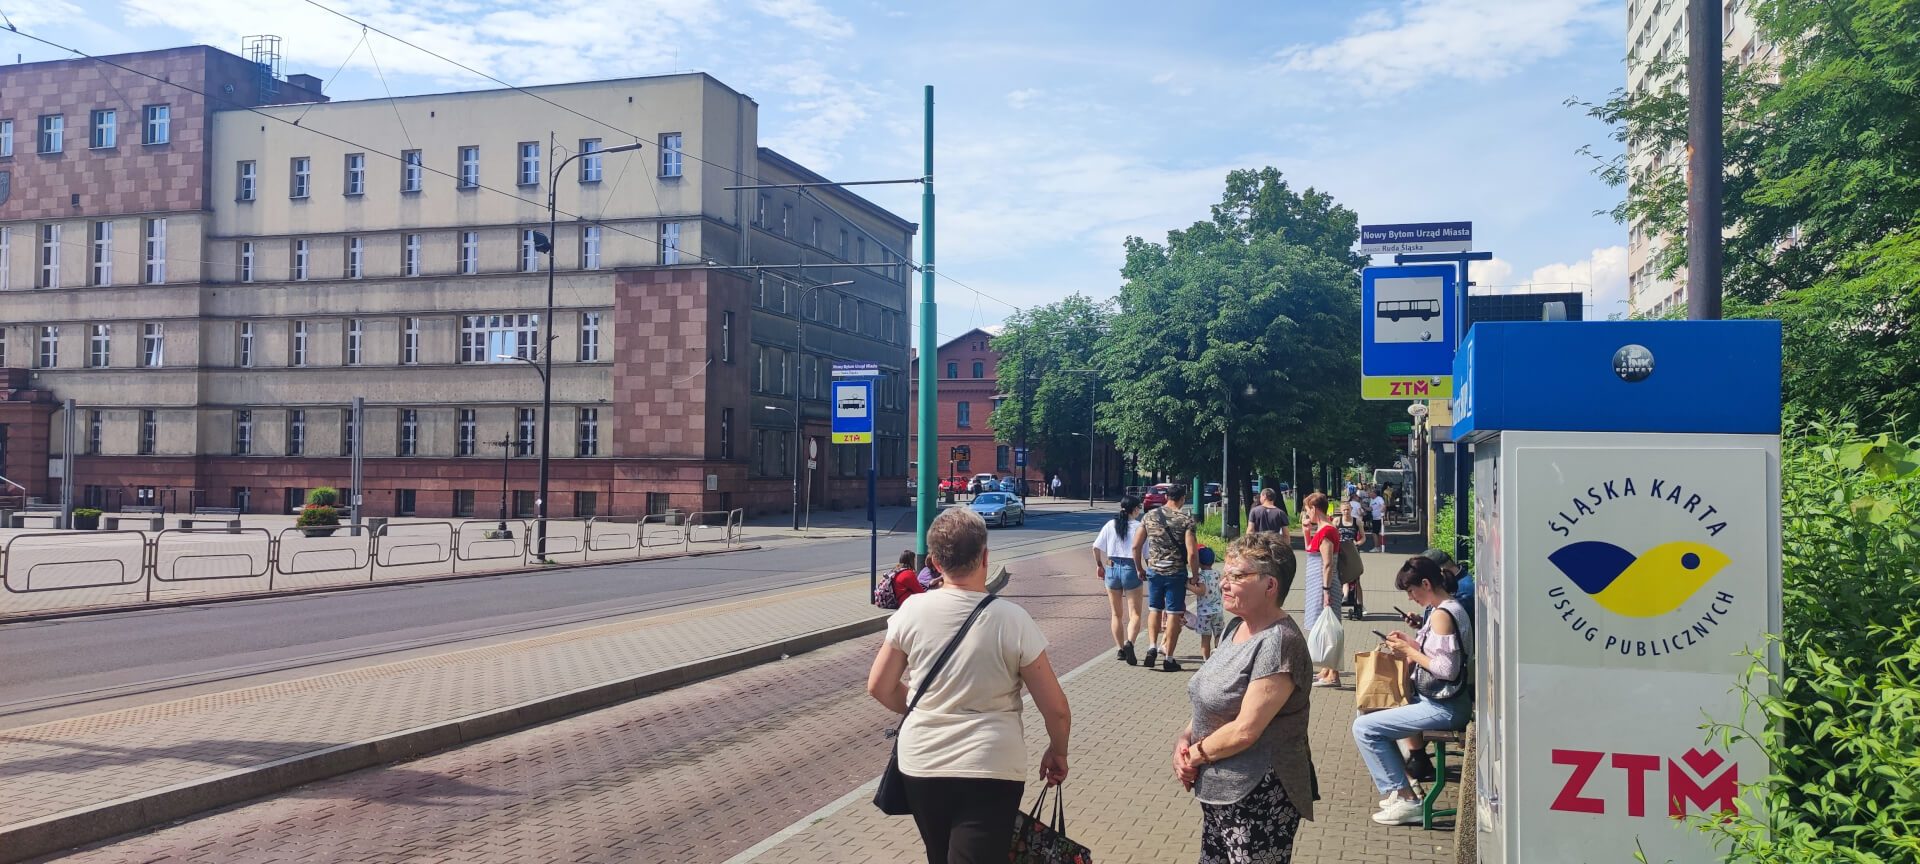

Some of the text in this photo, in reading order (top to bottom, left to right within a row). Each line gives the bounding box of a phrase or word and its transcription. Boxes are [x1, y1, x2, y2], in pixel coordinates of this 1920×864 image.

[1363, 228, 1470, 240] Nowy Bytom Urząd Miasta
[1401, 243, 1423, 252] Śląska
[1390, 379, 1428, 396] ZTM
[844, 434, 861, 442] ZTM
[1548, 477, 1728, 537] ŚLĄSKA KARTA
[1548, 586, 1735, 657] USŁUG PUBLICZNYCH
[1550, 747, 1739, 823] ZTM
